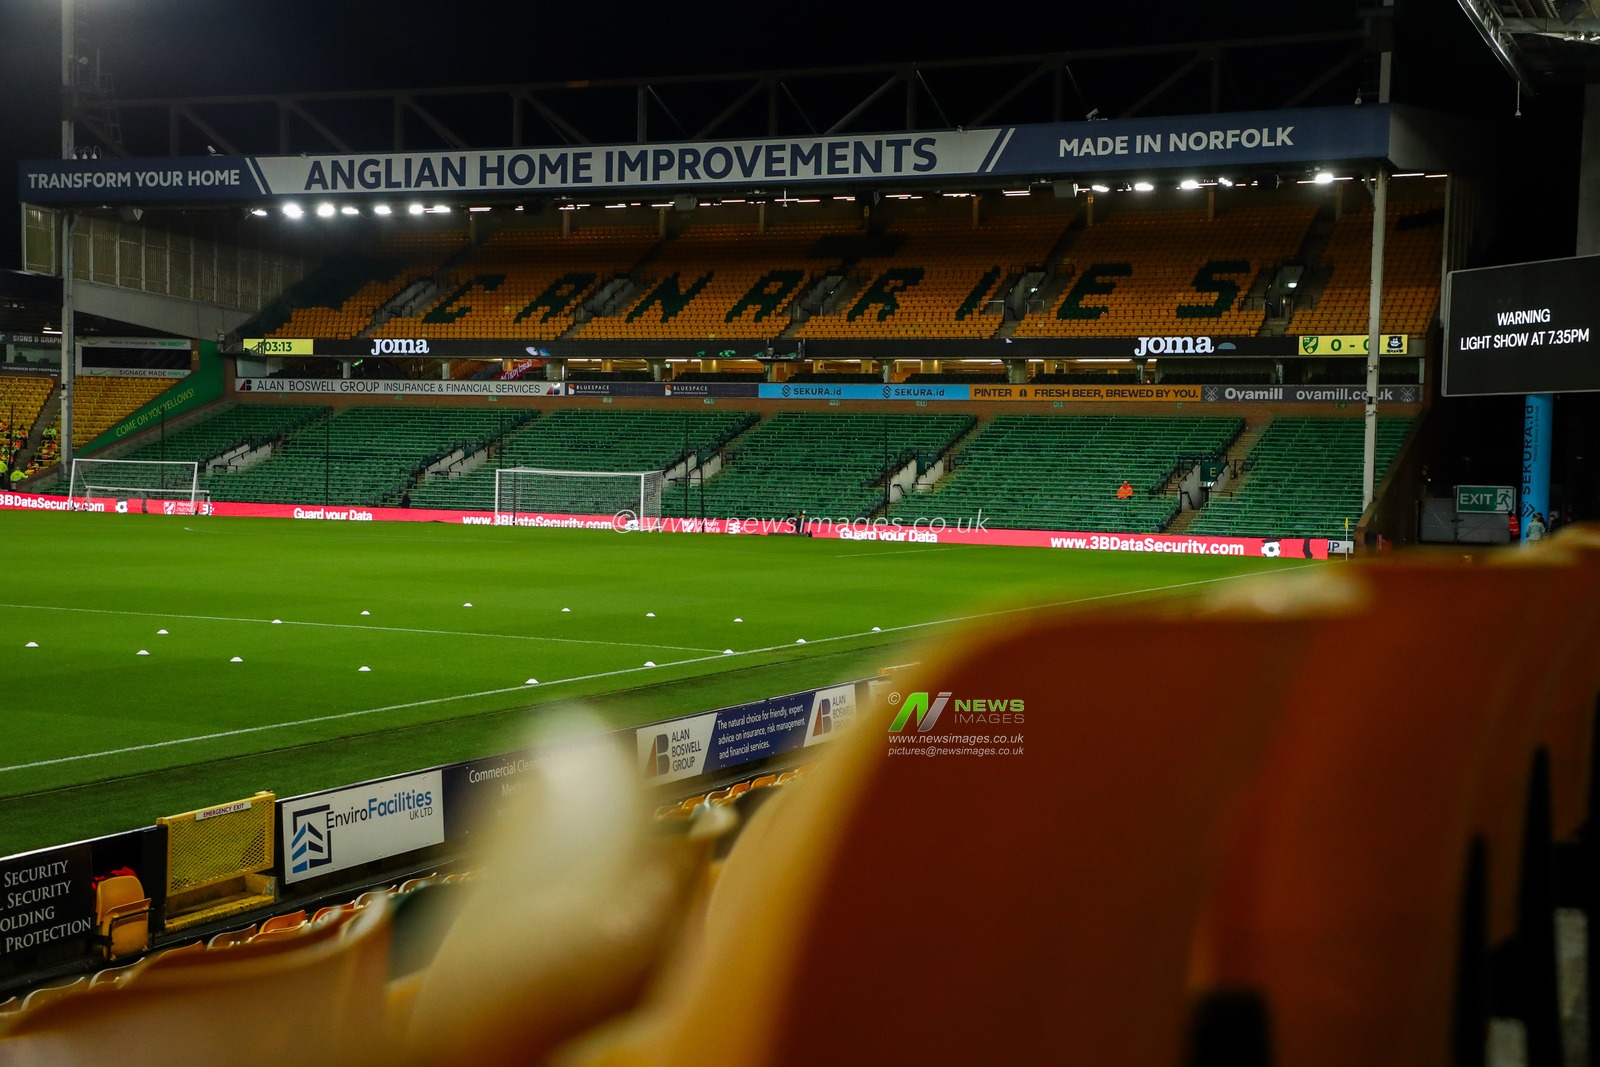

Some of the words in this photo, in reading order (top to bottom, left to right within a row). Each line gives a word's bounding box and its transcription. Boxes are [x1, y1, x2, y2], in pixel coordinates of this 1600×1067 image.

[1059, 135, 1129, 157] MADE
[1136, 134, 1162, 154] IN
[1169, 126, 1295, 152] NORFOLK
[305, 155, 466, 191] ANGLIAN
[480, 151, 593, 187] HOME
[605, 138, 937, 183] IMPROVEMENTS
[28, 172, 131, 189] TRANSFORM
[135, 170, 183, 187] YOUR
[188, 169, 240, 186] HOME
[421, 260, 1252, 324] CANARIES
[1497, 308, 1551, 326] WARNING
[40, 336, 62, 344] GRAPH
[1460, 335, 1492, 351] LIGHT
[1493, 333, 1529, 349] SHOW
[1531, 331, 1546, 346] AT
[1547, 328, 1590, 345] 7.35PM
[257, 381, 285, 391] ALAN
[289, 381, 336, 392] BOSWELL
[340, 382, 380, 392] GROUP
[384, 383, 435, 392] INSURANCE
[438, 384, 444, 392] &
[446, 384, 493, 393] FINANCIAL
[495, 384, 541, 393] SERVICES
[794, 387, 842, 396] SEKURA.id
[895, 389, 945, 397] SEKURA.id
[974, 388, 1013, 398] PINTER
[1034, 389, 1071, 398] FRESH
[1072, 389, 1104, 399] BEER,
[1106, 389, 1154, 398] BREWED
[1156, 389, 1171, 398] BY
[1172, 389, 1199, 399] YOU.
[116, 419, 137, 437] COME
[137, 413, 149, 426] ON
[162, 387, 194, 411] YELLOWS!
[1209, 467, 1217, 477] E
[1459, 493, 1494, 505] EXIT
[293, 507, 324, 520] Guard
[348, 509, 373, 521] Data
[839, 527, 876, 541] Guard
[908, 529, 938, 543] Data
[1050, 535, 1244, 556] www.3BDataSecurity.com
[832, 694, 847, 706] ALAN
[717, 718, 728, 731] The
[728, 715, 746, 728] natural
[746, 713, 762, 726] choice
[762, 711, 770, 723] for
[770, 708, 788, 722] friendly,
[788, 704, 804, 718] expert
[671, 728, 690, 744] ALAN
[718, 732, 735, 746] advice
[735, 732, 743, 743] on
[743, 726, 767, 741] insurance,
[767, 723, 775, 735] risk
[775, 717, 806, 733] management
[671, 741, 702, 758] BOSWELL
[718, 748, 729, 760] and
[729, 743, 750, 758] financial
[750, 740, 771, 754] services.
[468, 761, 516, 784] Commercial
[672, 757, 696, 773] GROUP
[203, 806, 232, 818] EMERGENCY
[233, 803, 245, 812] EXIT
[326, 789, 433, 830] EnviroFacilities
[409, 808, 420, 821] UK
[420, 806, 433, 819] LTD
[4, 860, 68, 888] SECURITY
[7, 880, 72, 909] SECURITY
[5, 917, 92, 954] PROTECTION
